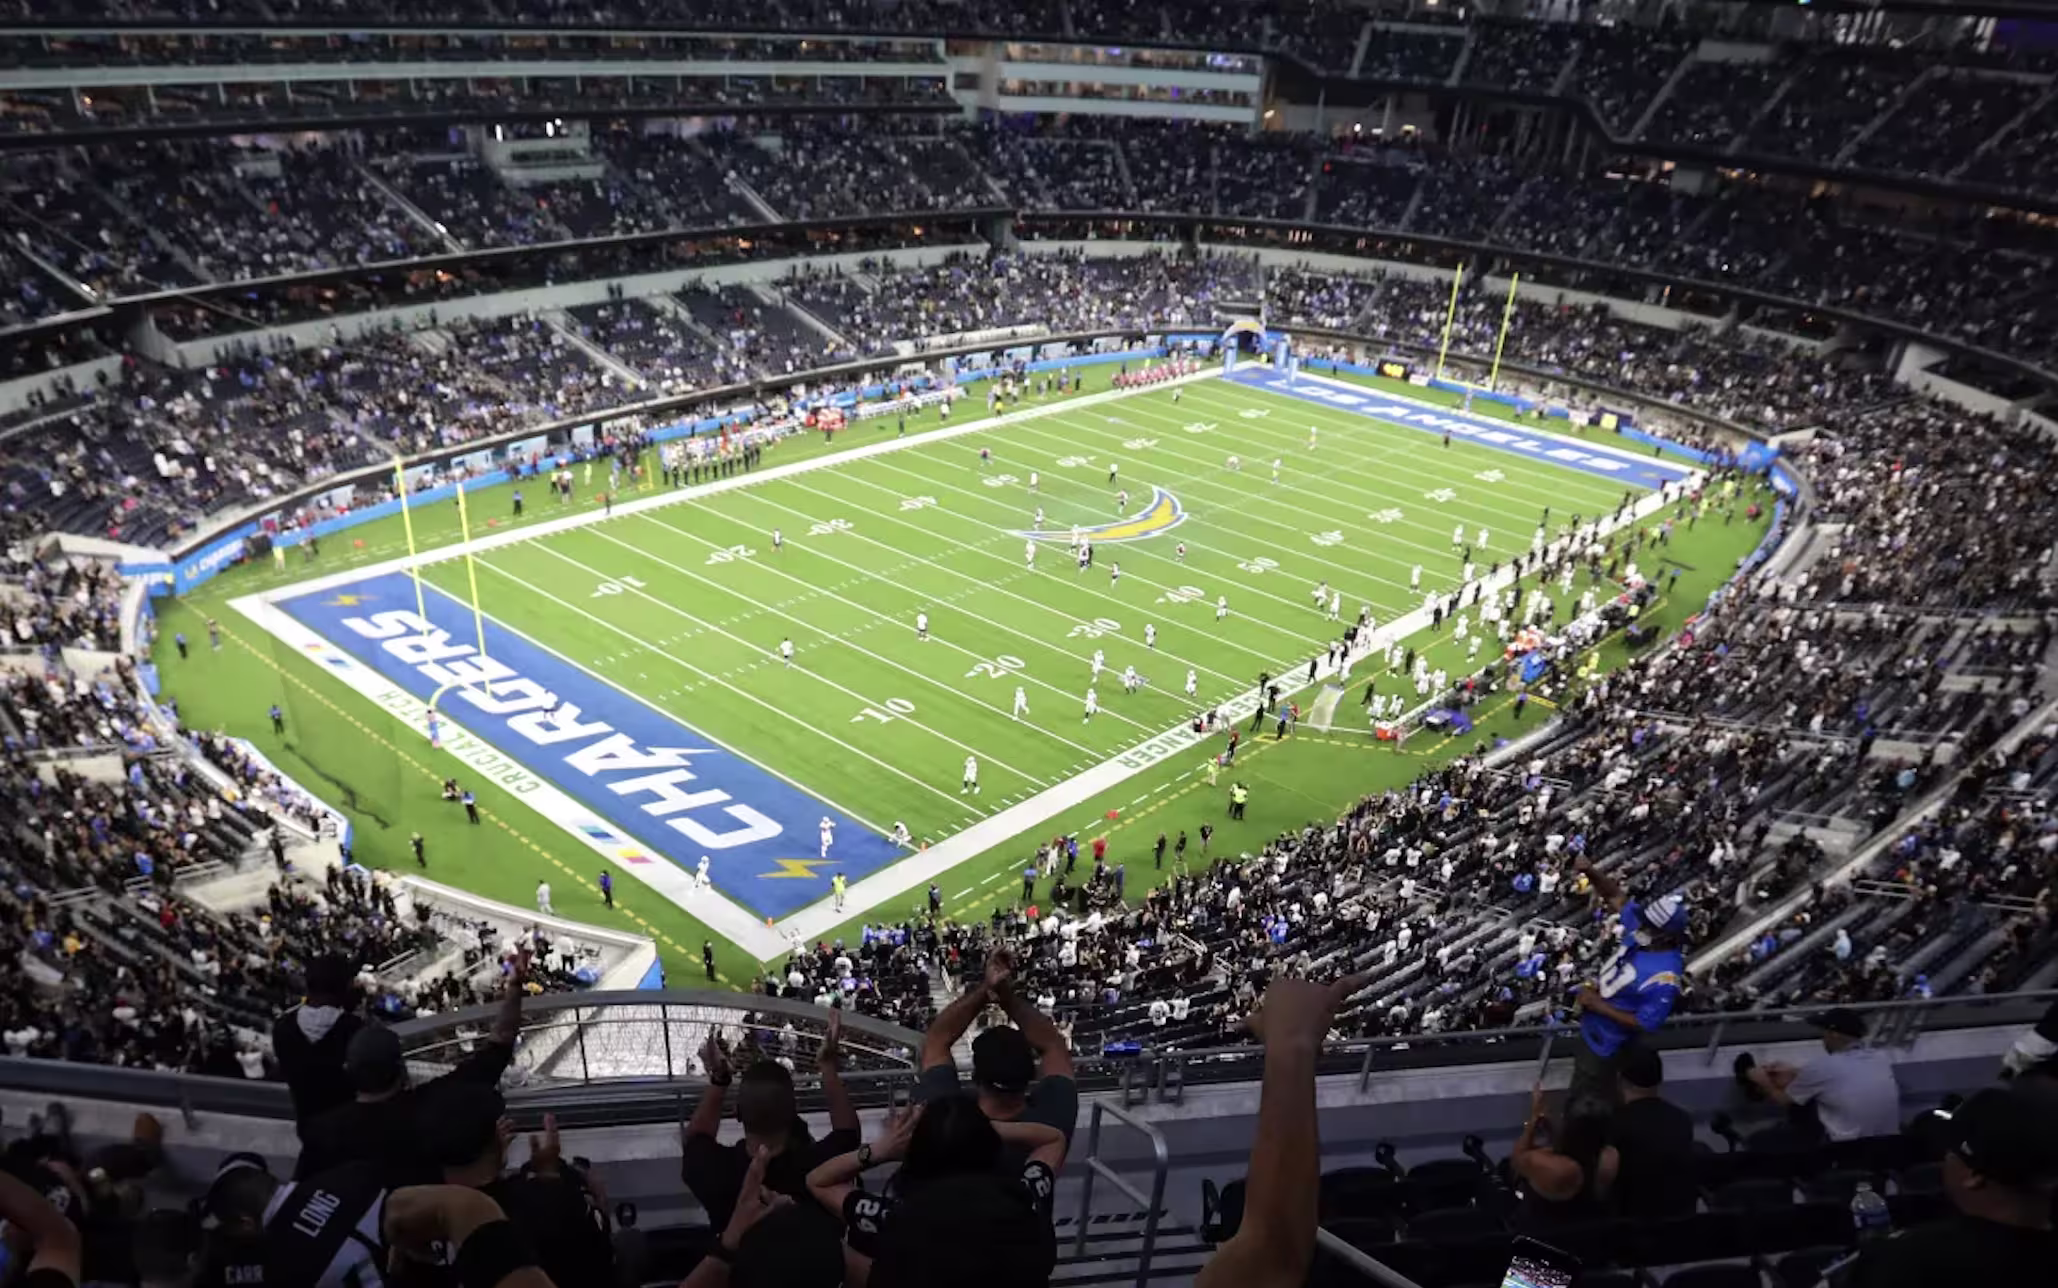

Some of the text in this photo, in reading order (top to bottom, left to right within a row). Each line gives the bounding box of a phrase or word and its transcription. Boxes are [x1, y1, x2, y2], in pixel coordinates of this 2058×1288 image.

[1265, 378, 1631, 471] LOS ANGELES
[711, 545, 756, 562] 20
[597, 576, 647, 594] 10
[1079, 618, 1121, 639] 30
[977, 655, 1025, 679] 20
[863, 698, 915, 724] 10
[342, 610, 784, 850] CHARGERS
[1117, 727, 1197, 769] ANCER
[445, 732, 541, 794] CRUCIAL
[292, 1189, 341, 1238] LONG
[224, 1264, 265, 1286] CARR
